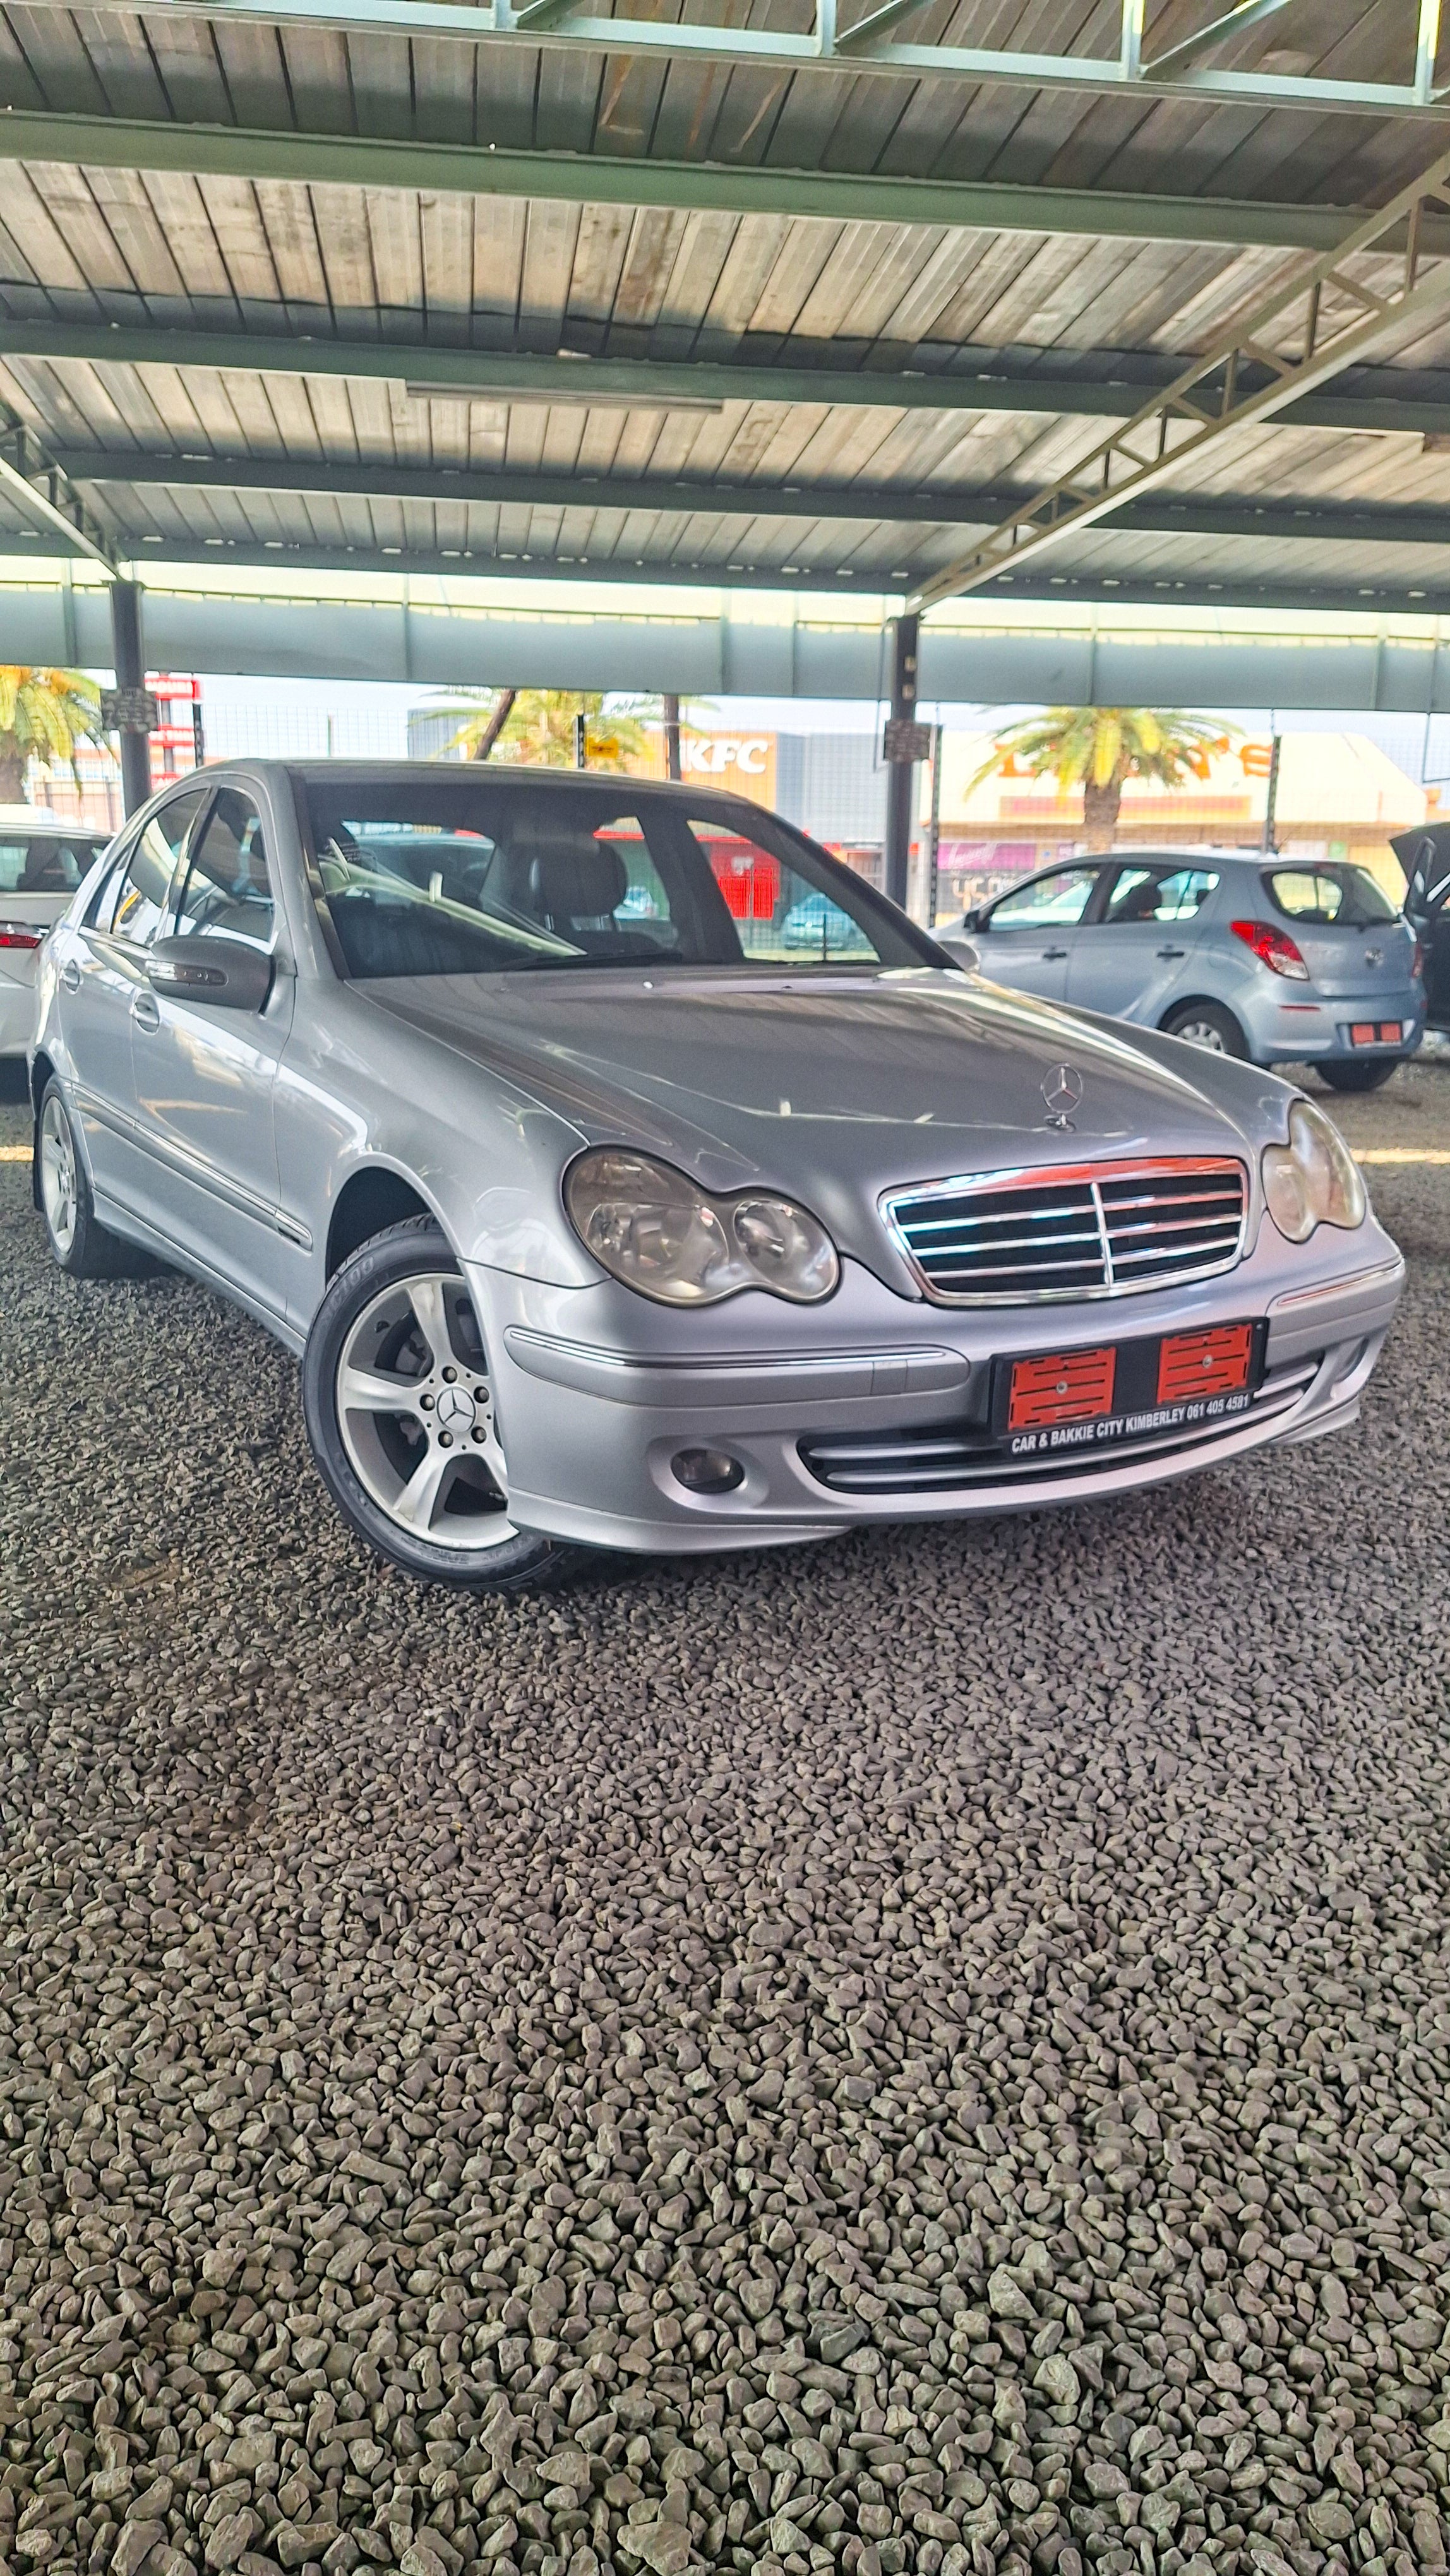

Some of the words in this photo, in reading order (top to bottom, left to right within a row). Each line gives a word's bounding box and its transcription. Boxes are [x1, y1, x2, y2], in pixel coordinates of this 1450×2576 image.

[679, 739, 769, 773] KFC
[1012, 1435, 1036, 1453] CAR
[1039, 1433, 1048, 1448] &
[1050, 1424, 1094, 1446] BAKKIE
[1096, 1418, 1123, 1438] CITY
[1125, 1406, 1185, 1433] KIMBERLEY
[1187, 1402, 1204, 1419] 061
[1206, 1398, 1225, 1415] 405
[1225, 1393, 1250, 1410] 4581
